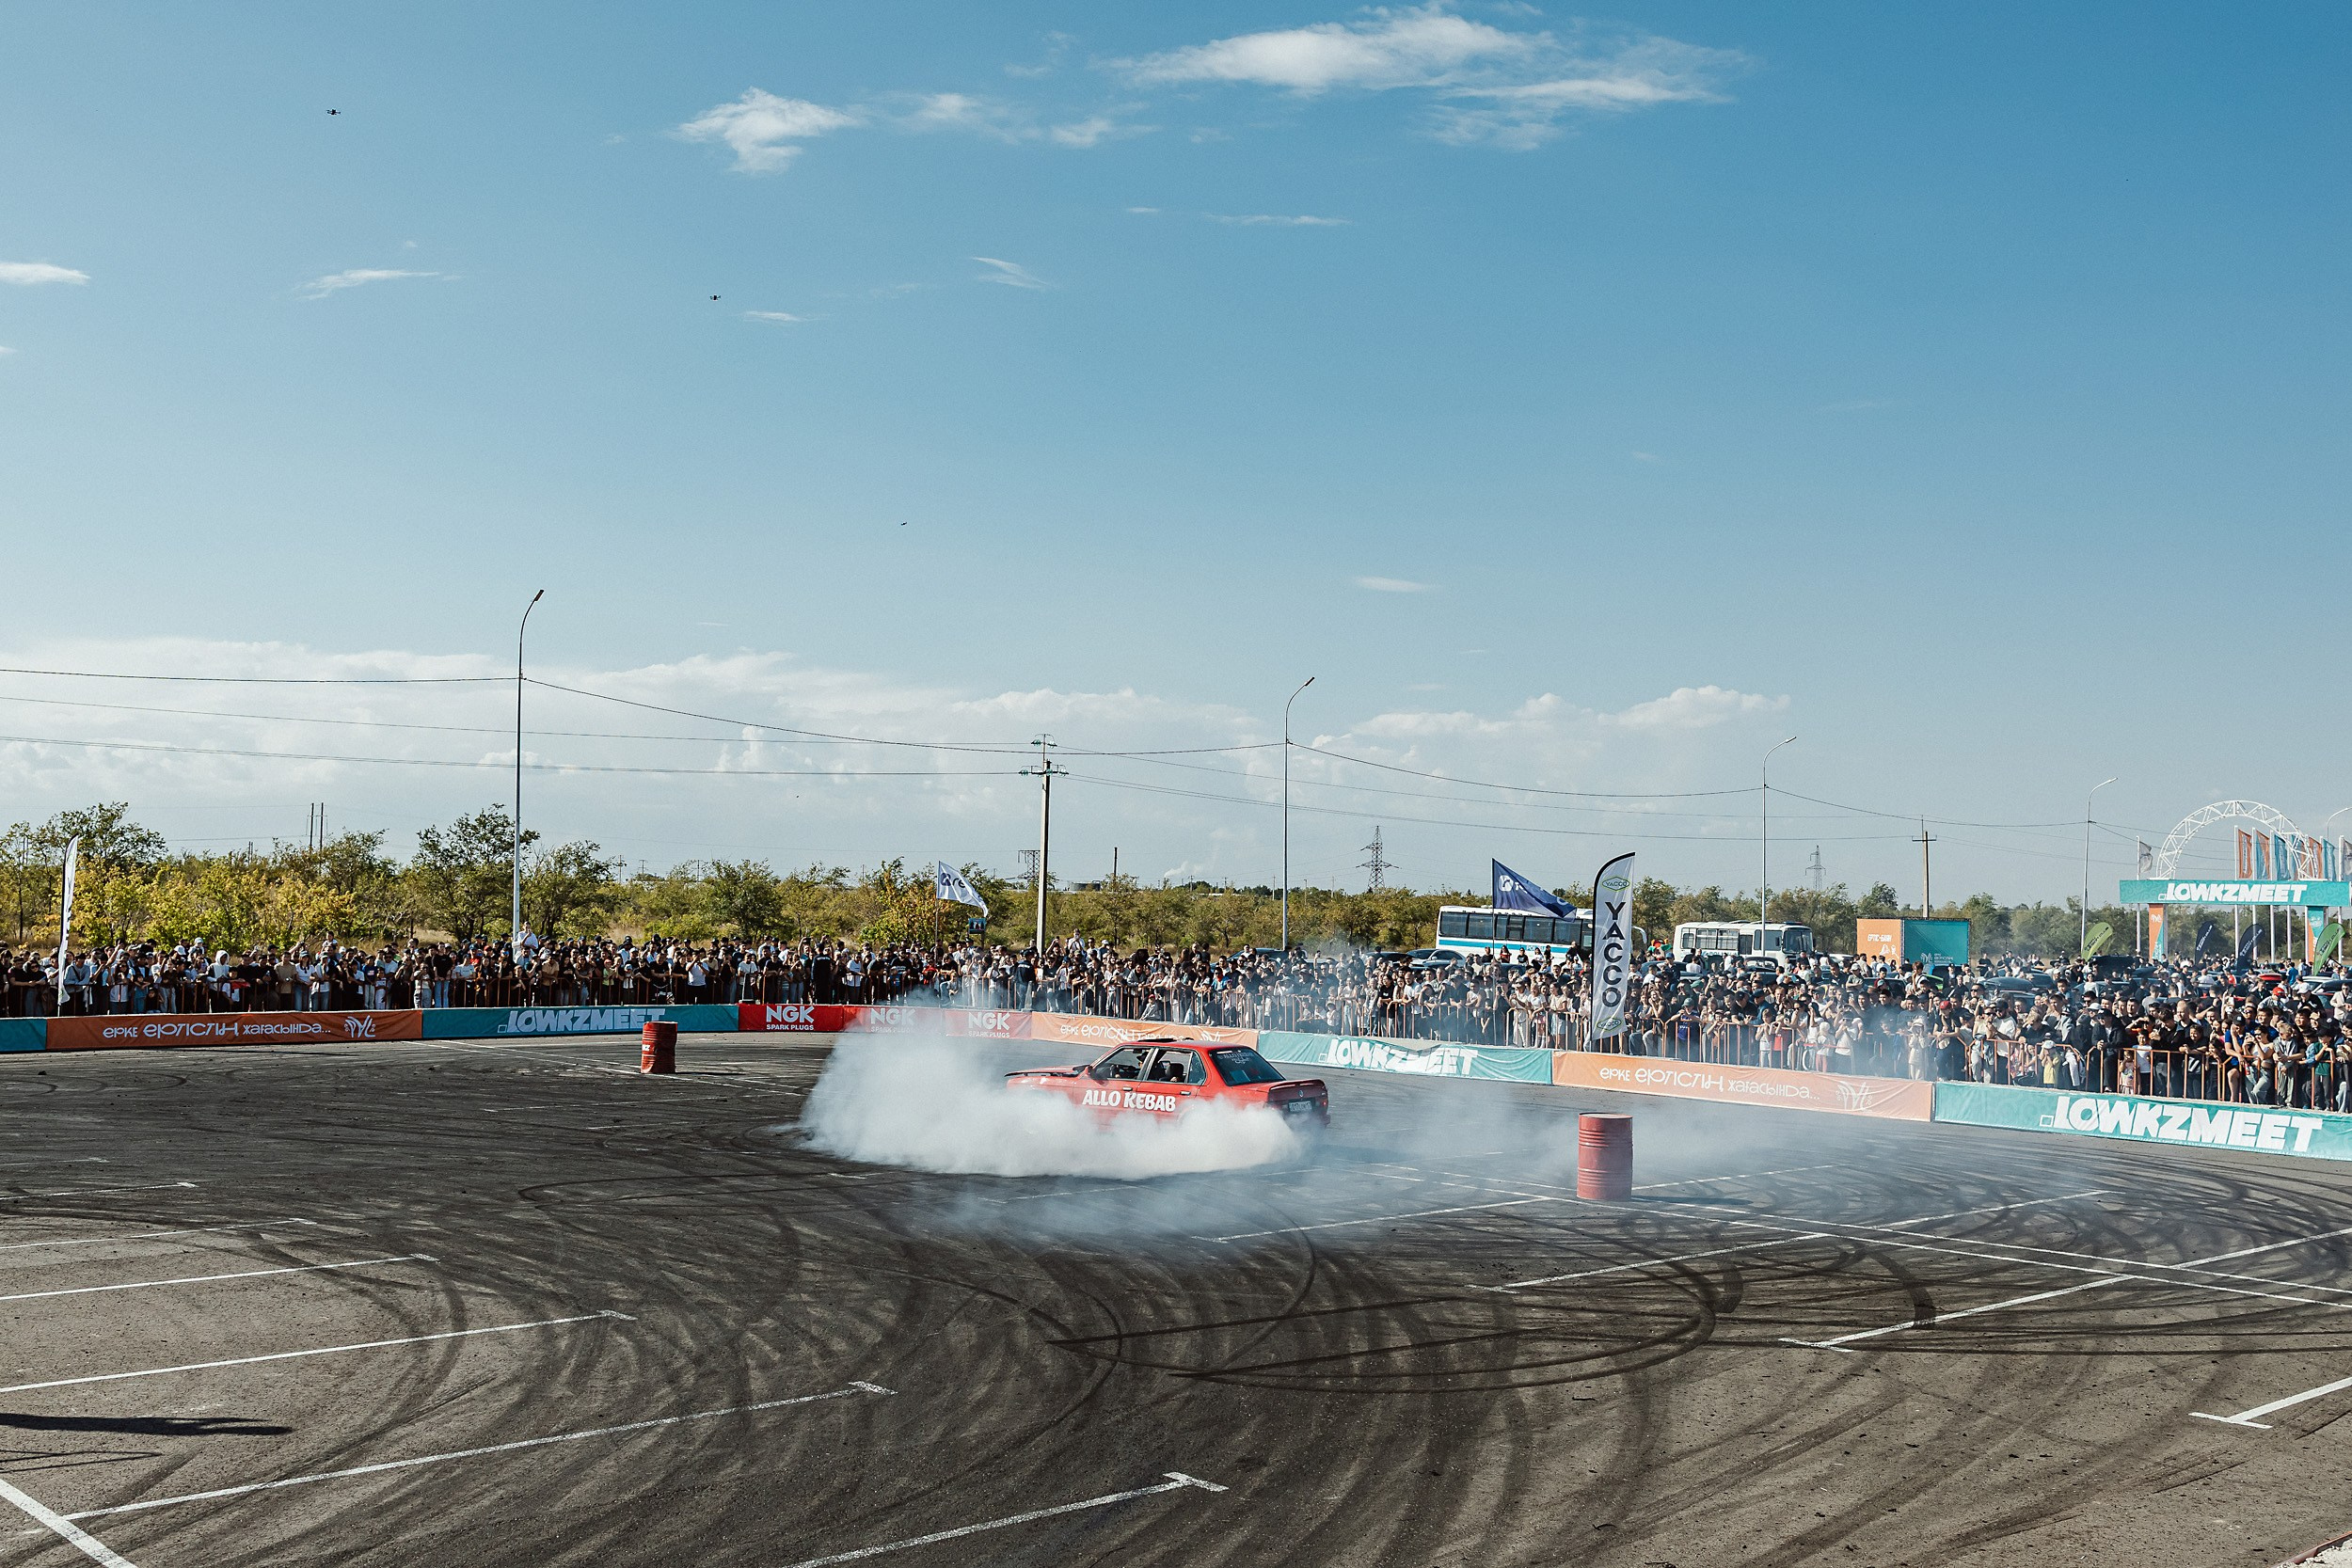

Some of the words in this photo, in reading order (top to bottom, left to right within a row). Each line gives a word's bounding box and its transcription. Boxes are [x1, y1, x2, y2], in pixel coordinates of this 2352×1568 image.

[2158, 882, 2307, 903] LOWKZMEET
[1601, 901, 1626, 1008] YACCO
[766, 1005, 815, 1024] NGK
[870, 1007, 916, 1026] NGK
[968, 1011, 1010, 1031] NGK
[1082, 1089, 1121, 1107] ALLO
[1123, 1091, 1176, 1112] KEBAB
[2040, 1096, 2323, 1153] LOWKZMEET
